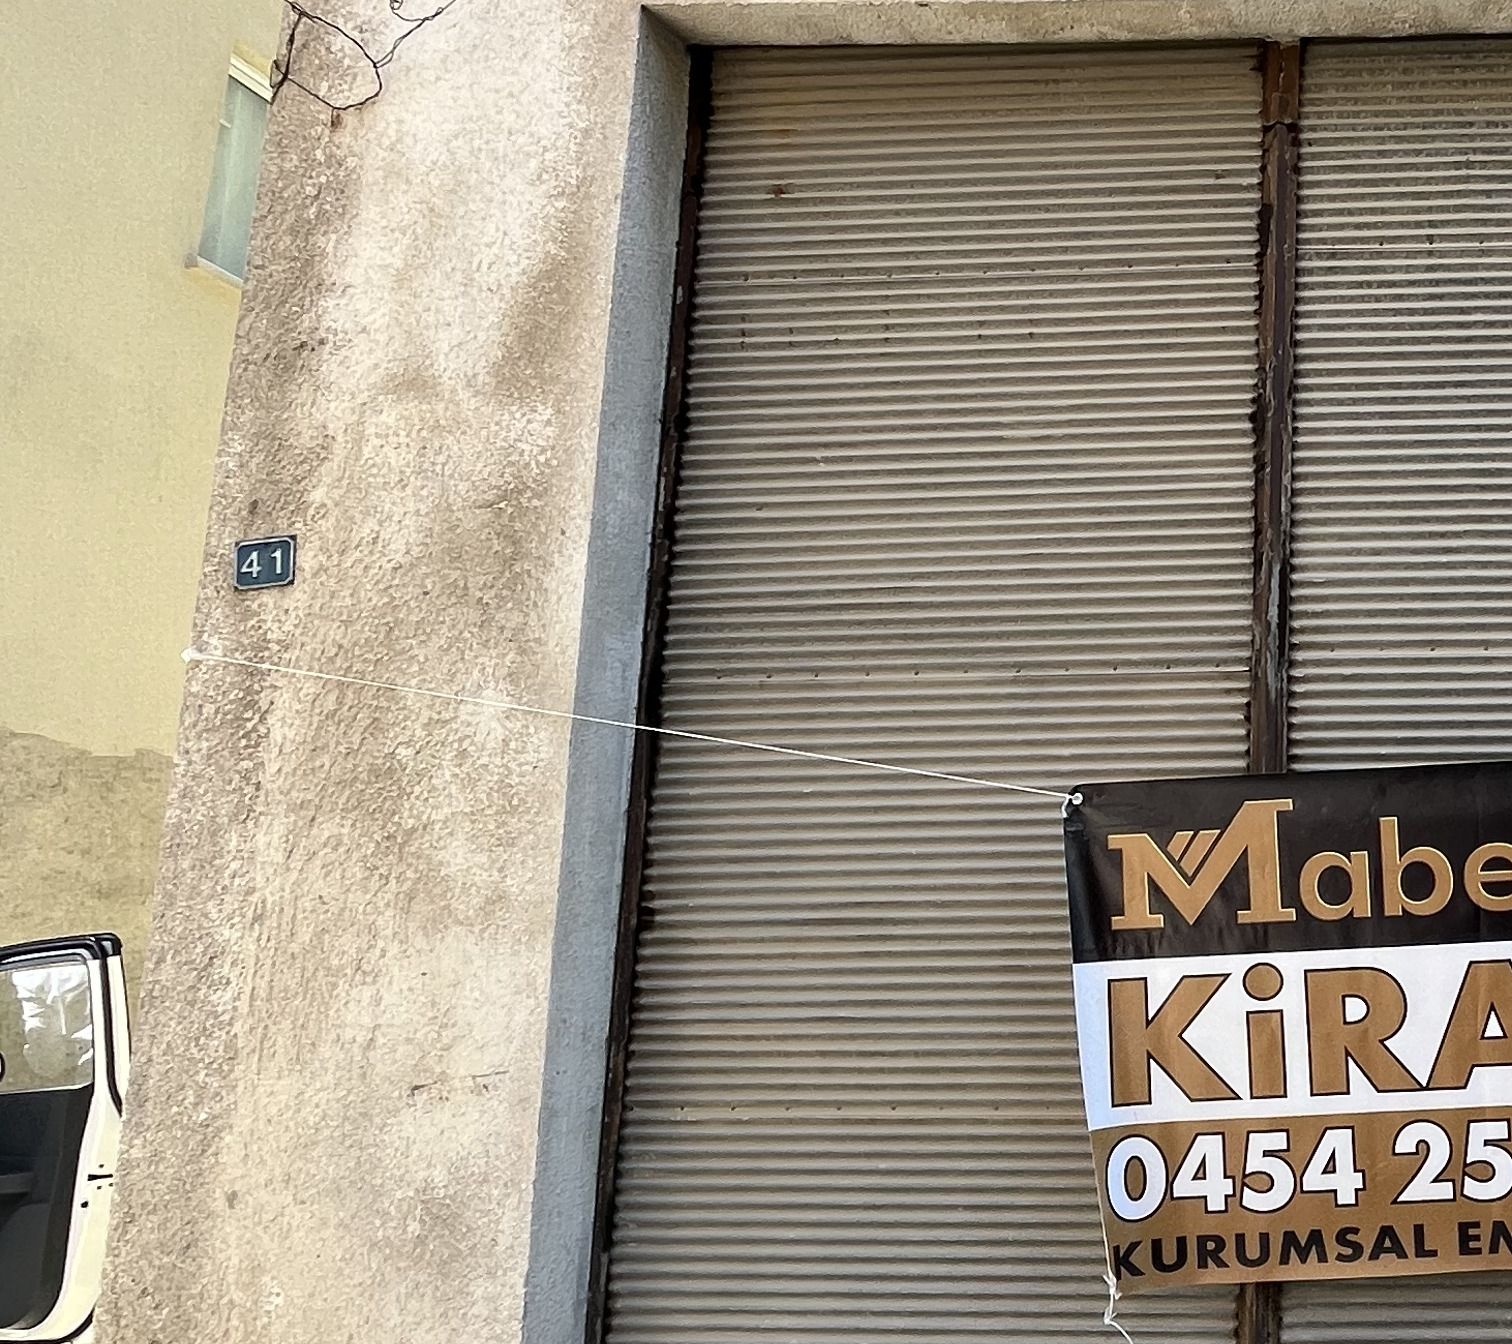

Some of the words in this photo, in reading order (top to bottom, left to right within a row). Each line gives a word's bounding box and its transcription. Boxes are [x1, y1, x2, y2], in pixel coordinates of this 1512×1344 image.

[240, 547, 282, 578] 41
[1105, 1126, 1366, 1223] 0454
[1113, 1223, 1439, 1281] KURUMSAL
